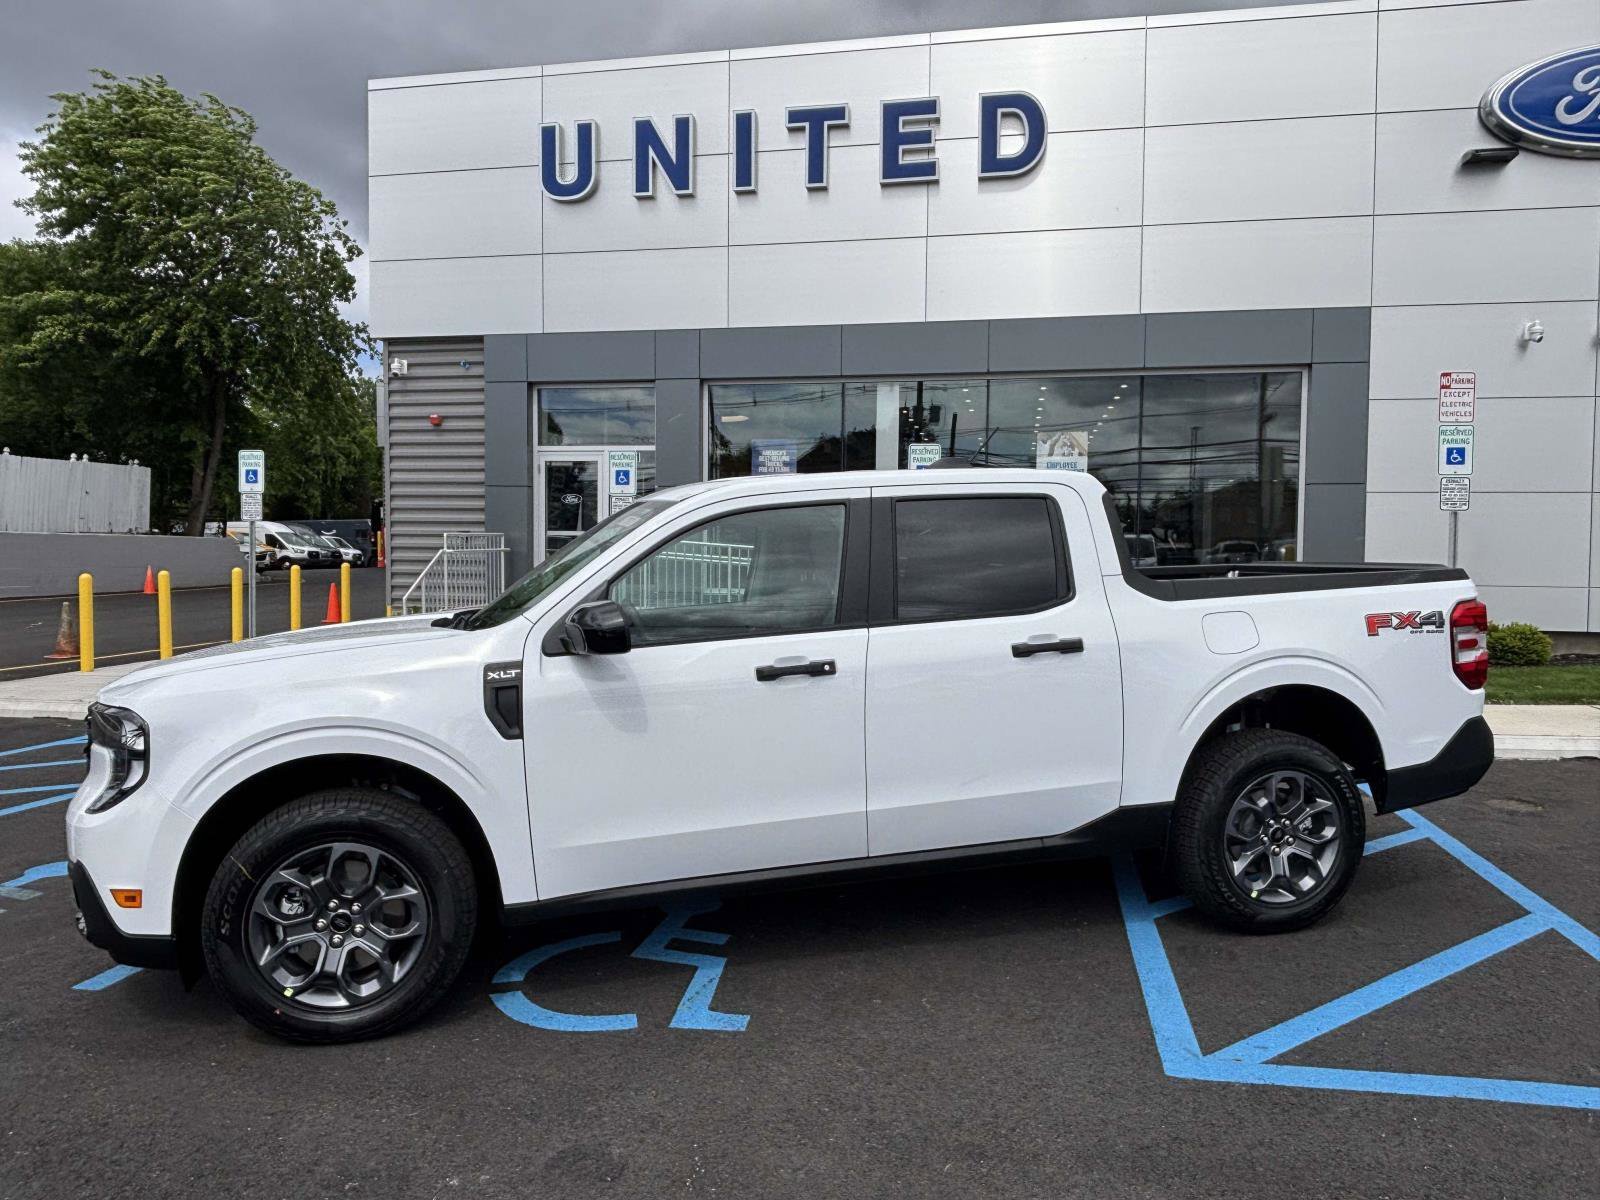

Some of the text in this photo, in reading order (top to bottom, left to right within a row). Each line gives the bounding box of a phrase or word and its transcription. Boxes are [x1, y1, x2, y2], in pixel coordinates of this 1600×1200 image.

[538, 91, 1048, 200] UNITED
[1441, 375, 1474, 386] NO PARKING
[1365, 611, 1445, 636] FX4
[487, 670, 520, 679] XLT
